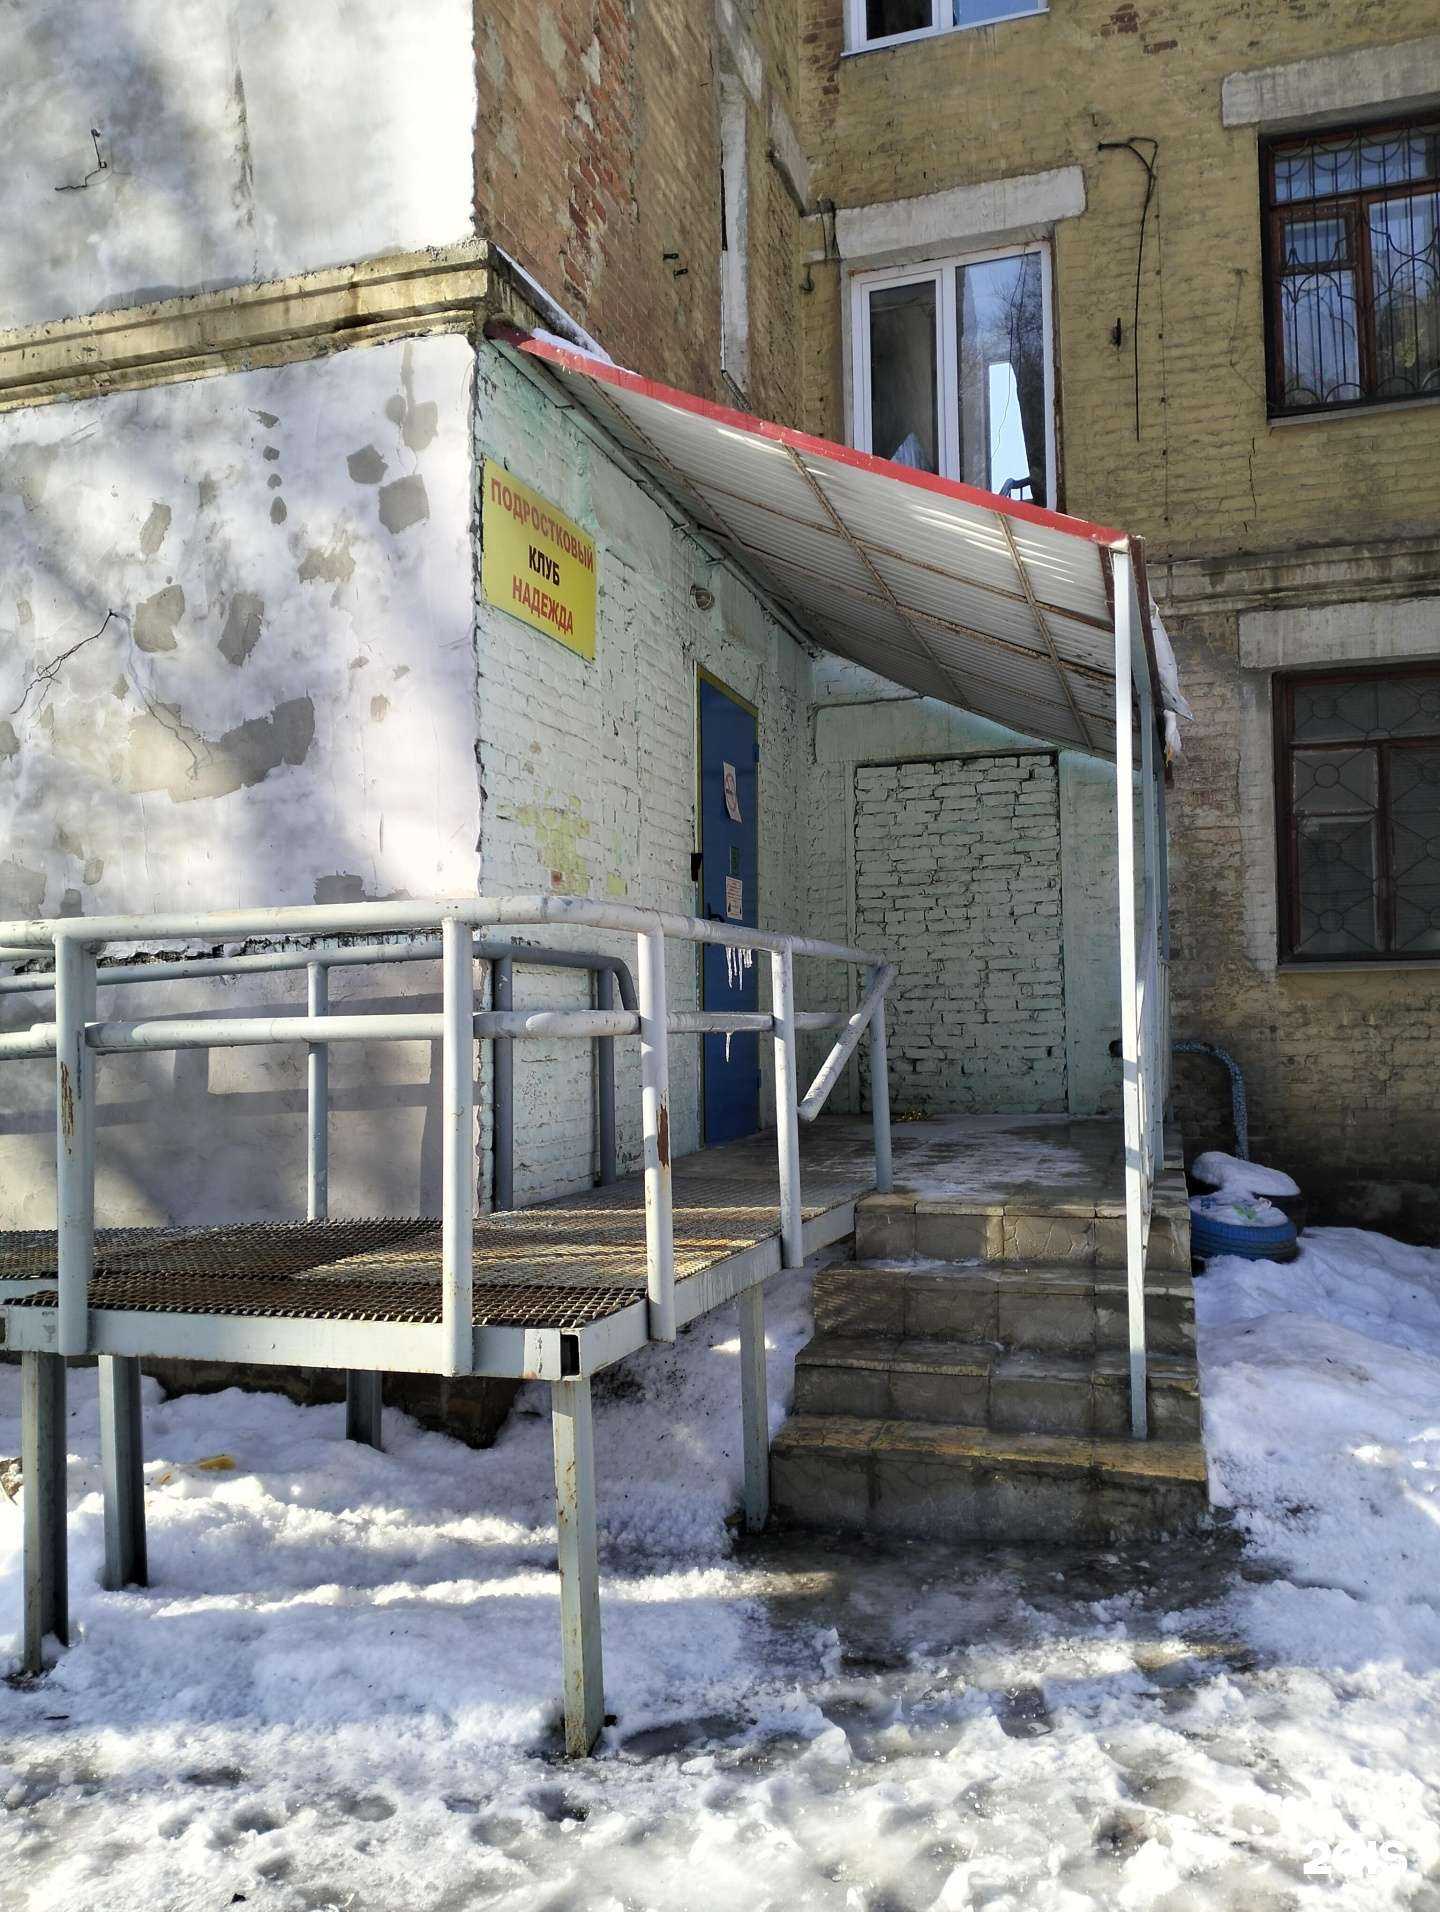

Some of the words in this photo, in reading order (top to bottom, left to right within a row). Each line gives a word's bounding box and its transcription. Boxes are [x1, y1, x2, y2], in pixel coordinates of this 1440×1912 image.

[491, 478, 594, 573] ПОДРОСТКОВЫЙ
[528, 543, 560, 586] КЛУБ
[512, 575, 574, 635] НАДЕЖДА
